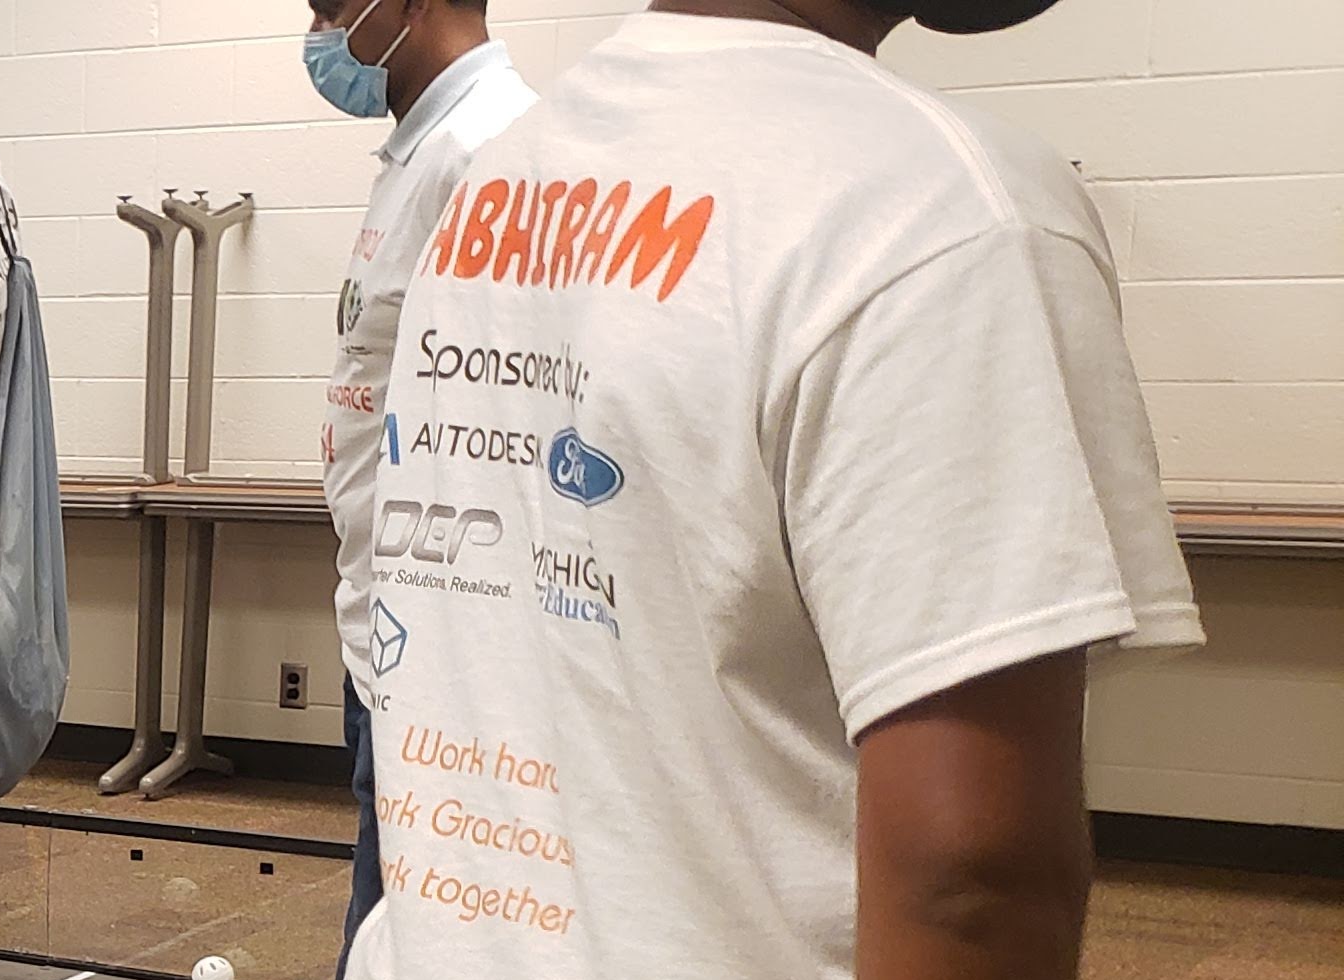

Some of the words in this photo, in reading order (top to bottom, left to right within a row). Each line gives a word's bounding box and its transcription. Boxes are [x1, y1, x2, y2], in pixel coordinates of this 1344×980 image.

[420, 178, 714, 303] ABHIRAM
[374, 500, 503, 566] DEP
[401, 725, 487, 777] Work
[377, 790, 421, 829] ork
[419, 867, 576, 935] together
